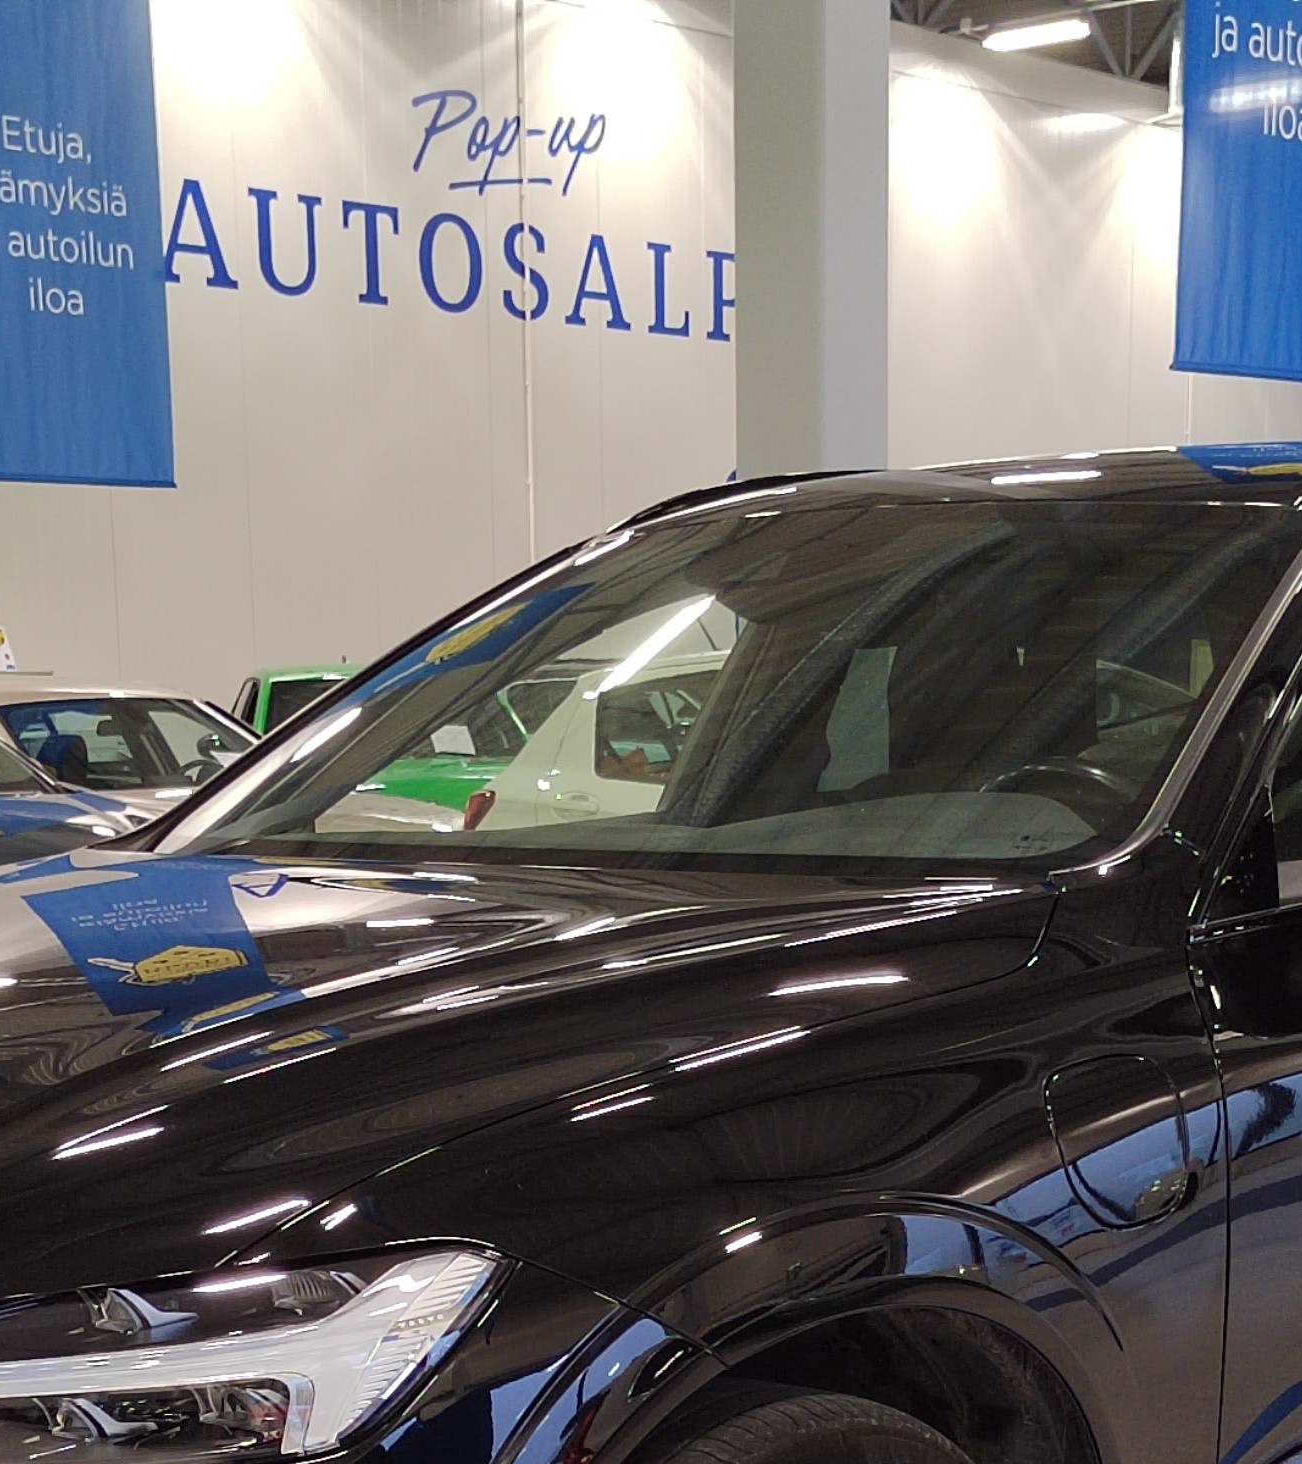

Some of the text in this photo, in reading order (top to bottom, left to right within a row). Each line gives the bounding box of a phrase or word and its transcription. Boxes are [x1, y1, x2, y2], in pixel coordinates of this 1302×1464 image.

[1211, 0, 1238, 58] ja
[2, 115, 92, 165] Etuja,
[412, 90, 606, 196] Pop-up
[8, 228, 135, 270] autoilun
[29, 277, 85, 315] iloa
